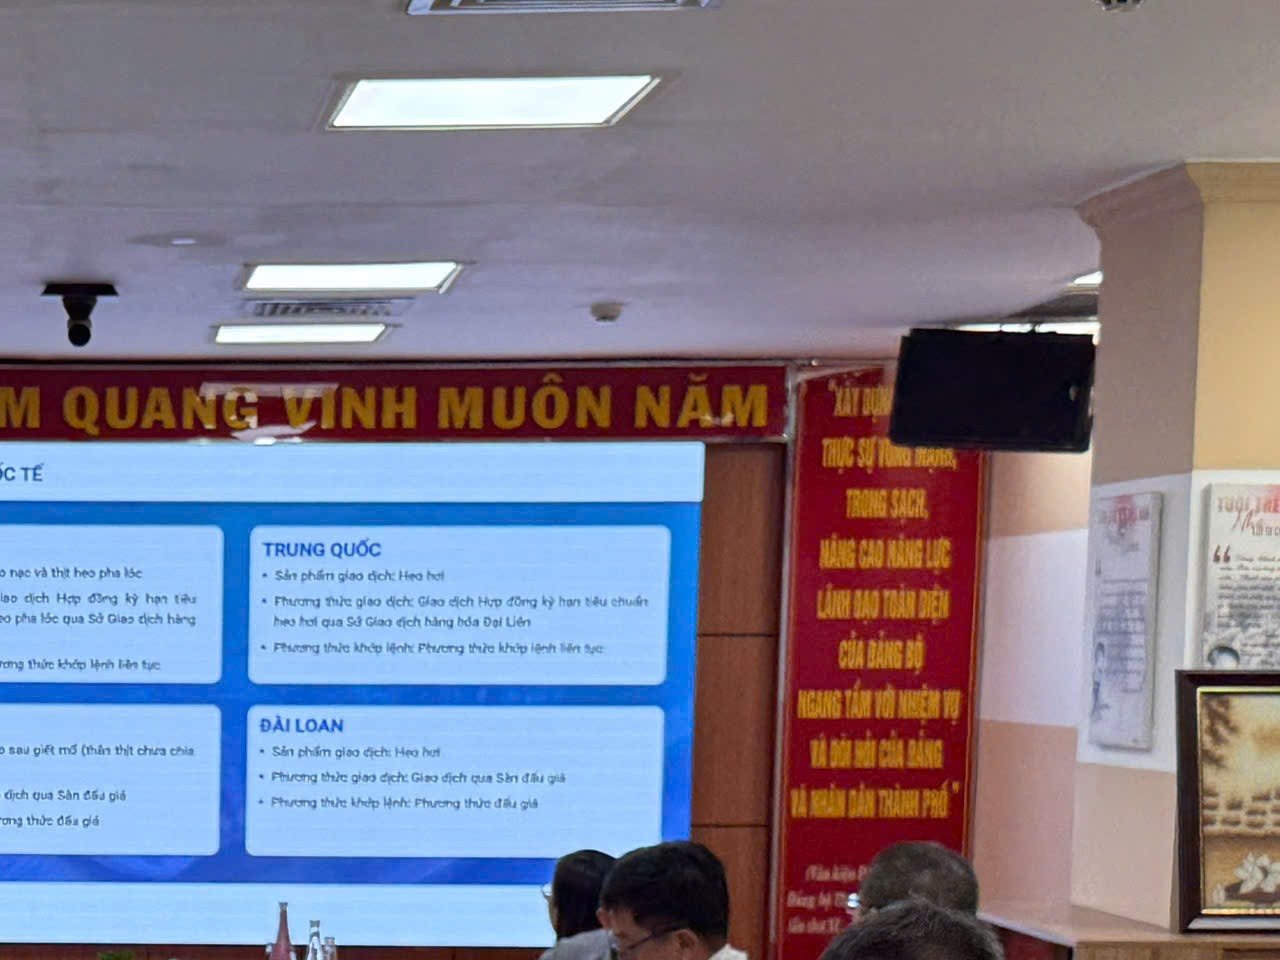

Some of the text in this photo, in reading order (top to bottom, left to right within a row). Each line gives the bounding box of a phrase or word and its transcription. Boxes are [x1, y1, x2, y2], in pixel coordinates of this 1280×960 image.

[63, 386, 259, 436] QUANG
[280, 385, 417, 430] VINH
[437, 372, 612, 430] MUÔN
[635, 373, 769, 429] NĂM
[20, 464, 44, 482] TẾ
[263, 539, 382, 560] TRUNG QUỐC
[259, 716, 344, 734] ĐÀI LOAN
